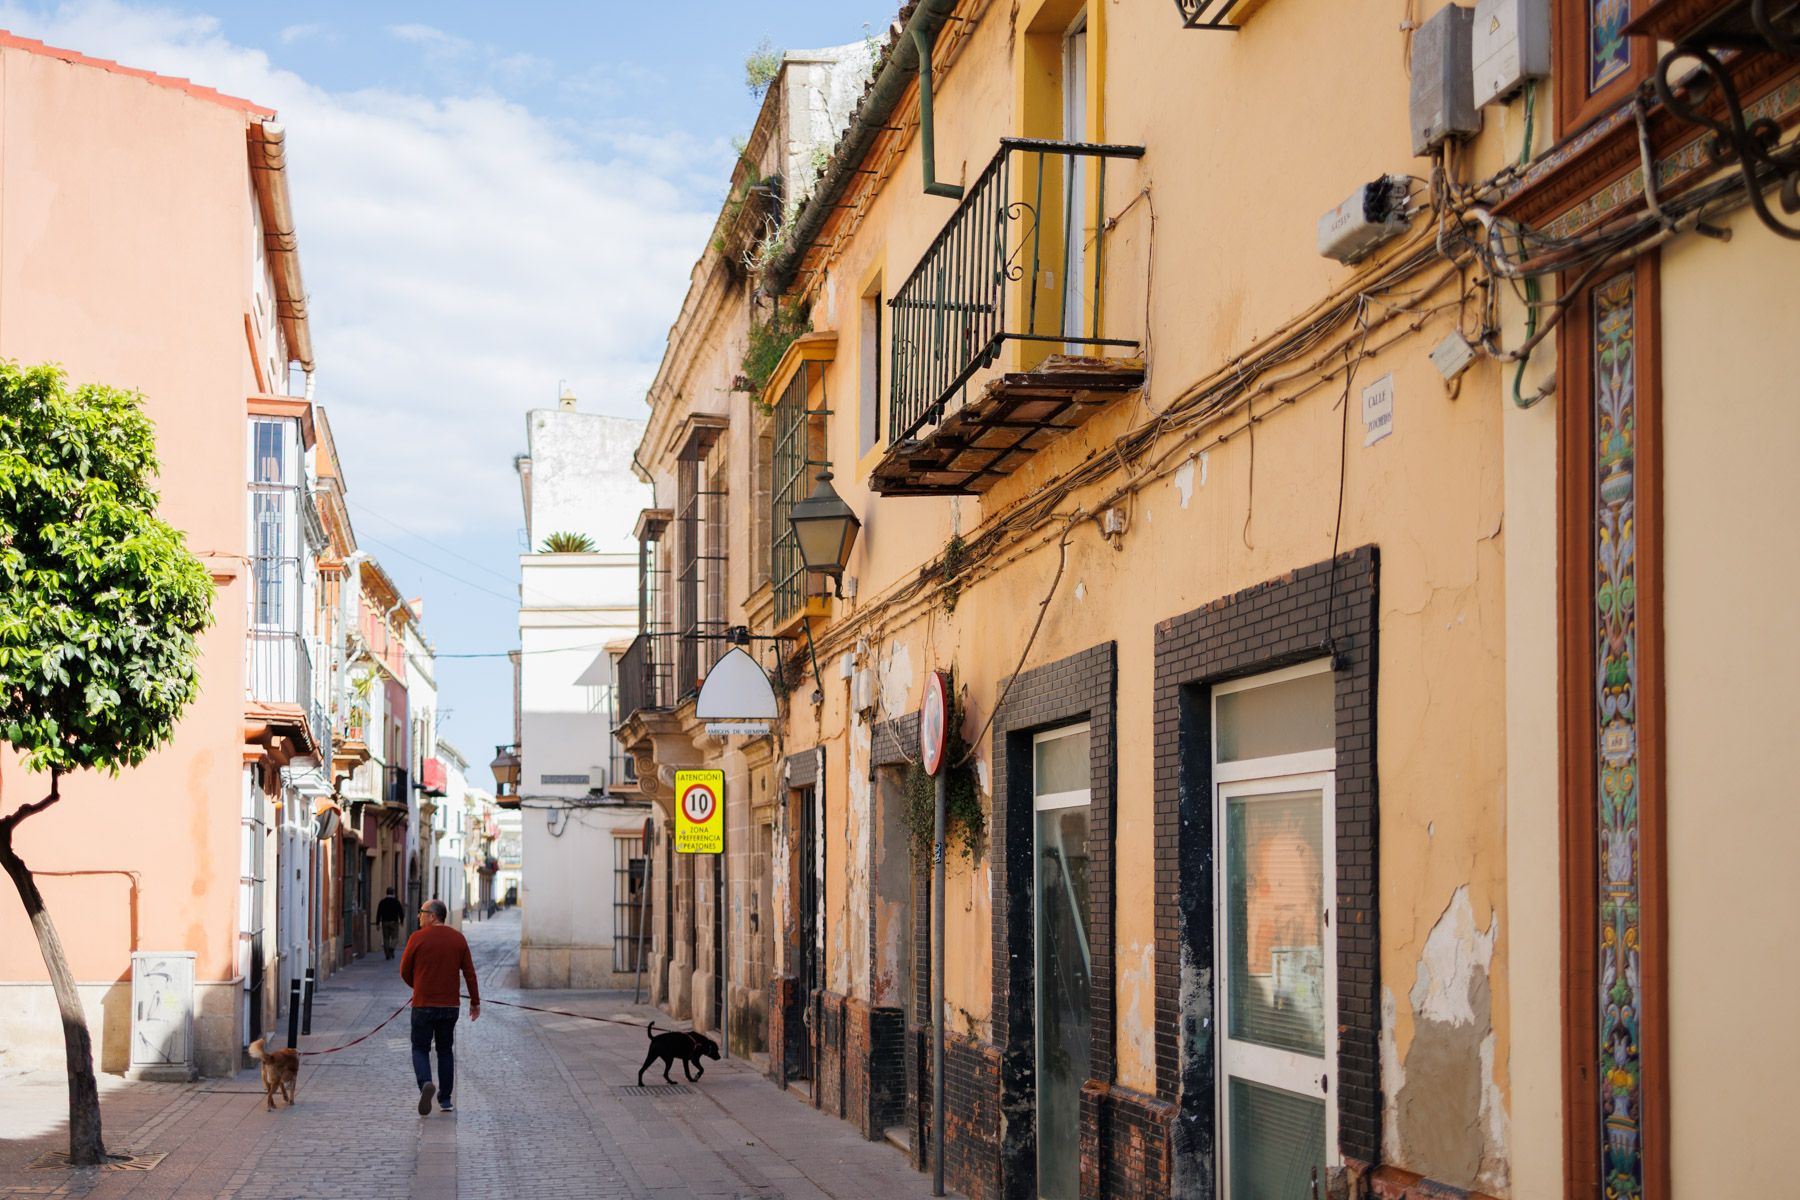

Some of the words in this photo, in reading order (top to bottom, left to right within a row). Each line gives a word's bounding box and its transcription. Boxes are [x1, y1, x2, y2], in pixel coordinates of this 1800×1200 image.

[1368, 390, 1385, 408] CALLE
[690, 793, 708, 812] 10
[683, 842, 717, 850] PEATONES
